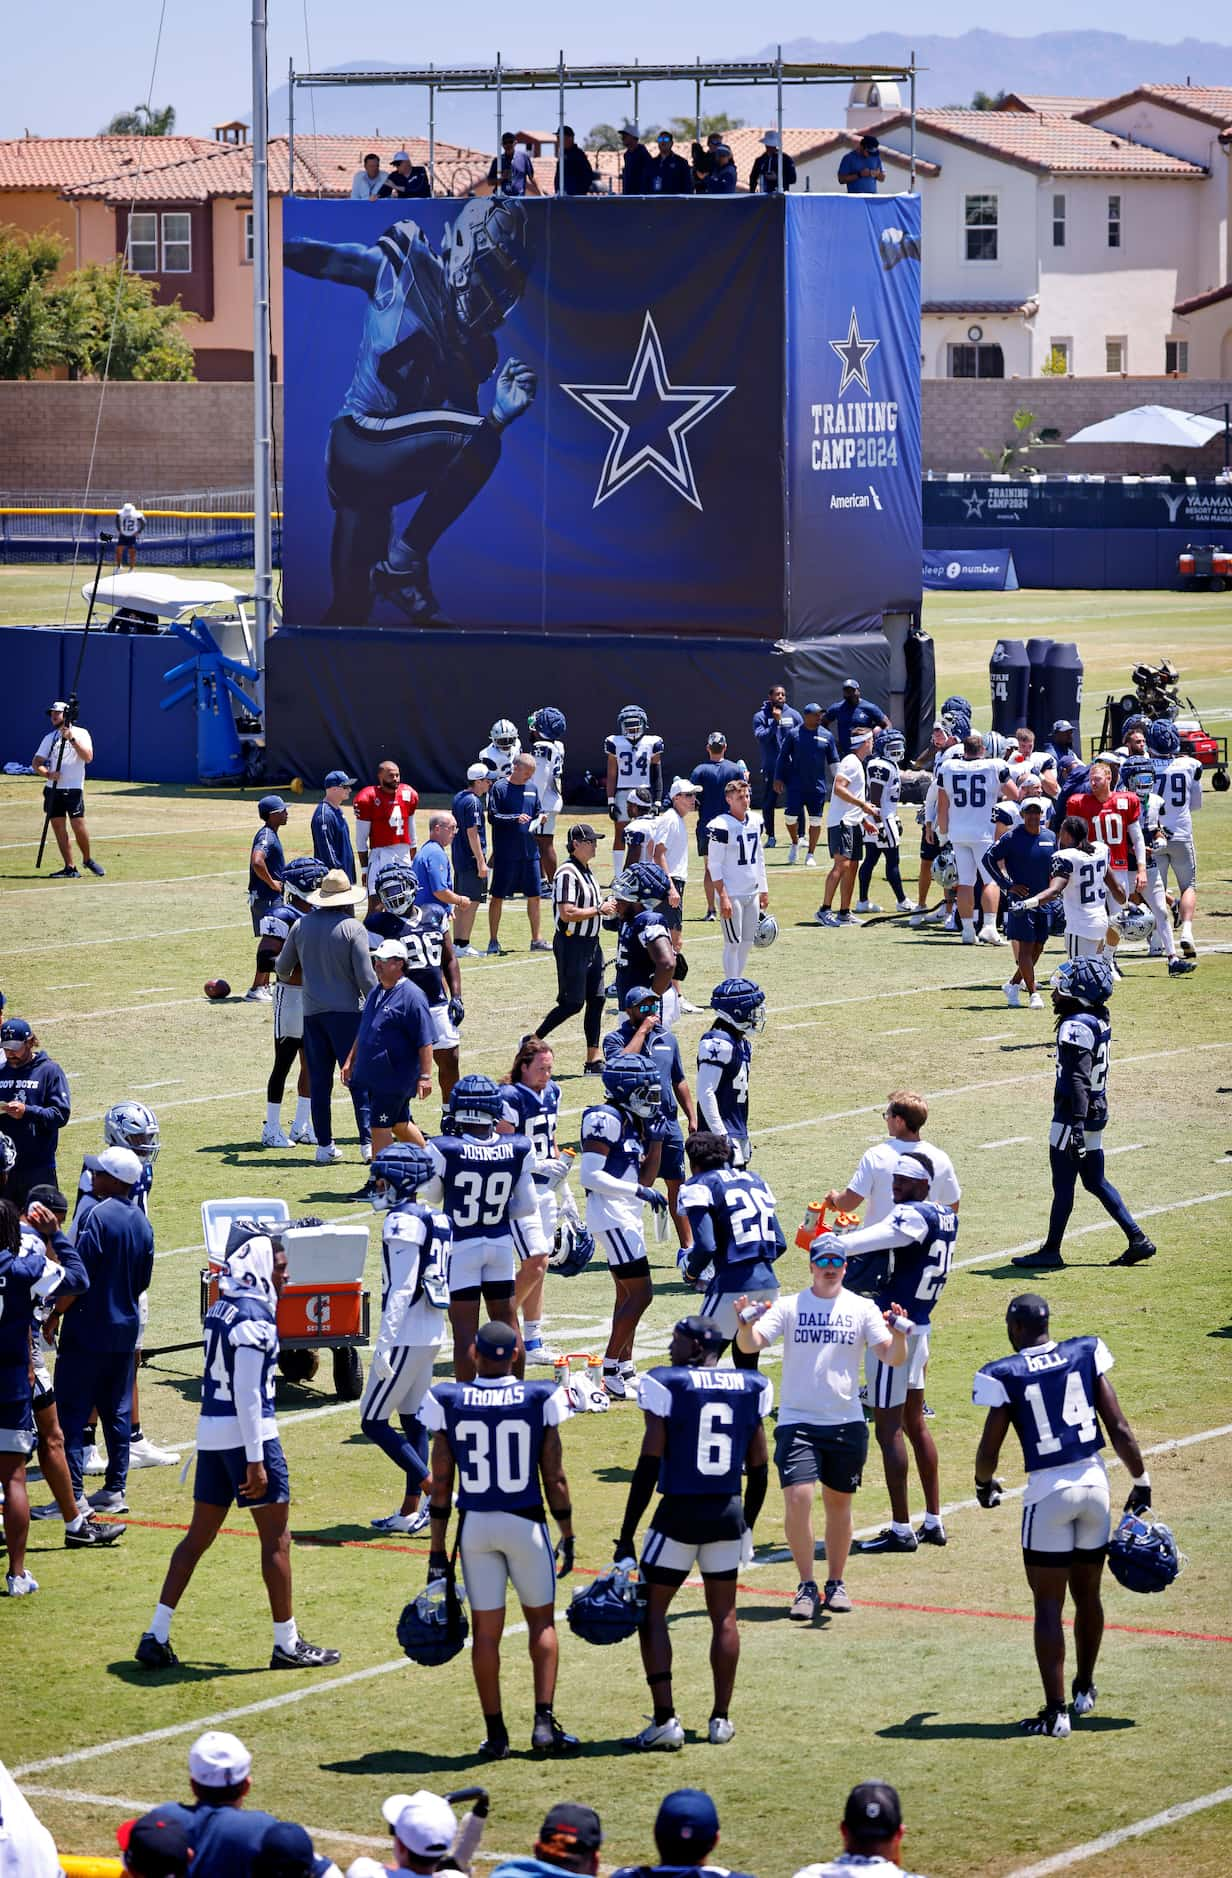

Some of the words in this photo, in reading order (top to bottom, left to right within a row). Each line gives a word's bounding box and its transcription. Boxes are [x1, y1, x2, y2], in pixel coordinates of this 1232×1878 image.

[811, 402, 898, 435] TRAINING
[830, 493, 870, 509] American
[987, 487, 1029, 498] TRAINING
[961, 563, 1001, 574] number
[619, 751, 649, 777] 34
[951, 774, 987, 808] 56
[1154, 773, 1187, 807] 79
[388, 805, 404, 836] 4
[1092, 813, 1123, 845] 10
[736, 832, 759, 866] 17
[460, 1143, 515, 1161] JOHNSON
[452, 1170, 513, 1228] 39
[798, 1312, 853, 1328] DALLAS
[794, 1329, 856, 1345] COWBOYS
[1024, 1352, 1069, 1373] BELL
[688, 1369, 745, 1391] WILSON
[462, 1385, 525, 1406] THOMAS
[1023, 1370, 1097, 1457] 14
[696, 1402, 734, 1476] 6
[454, 1419, 532, 1494] 30
